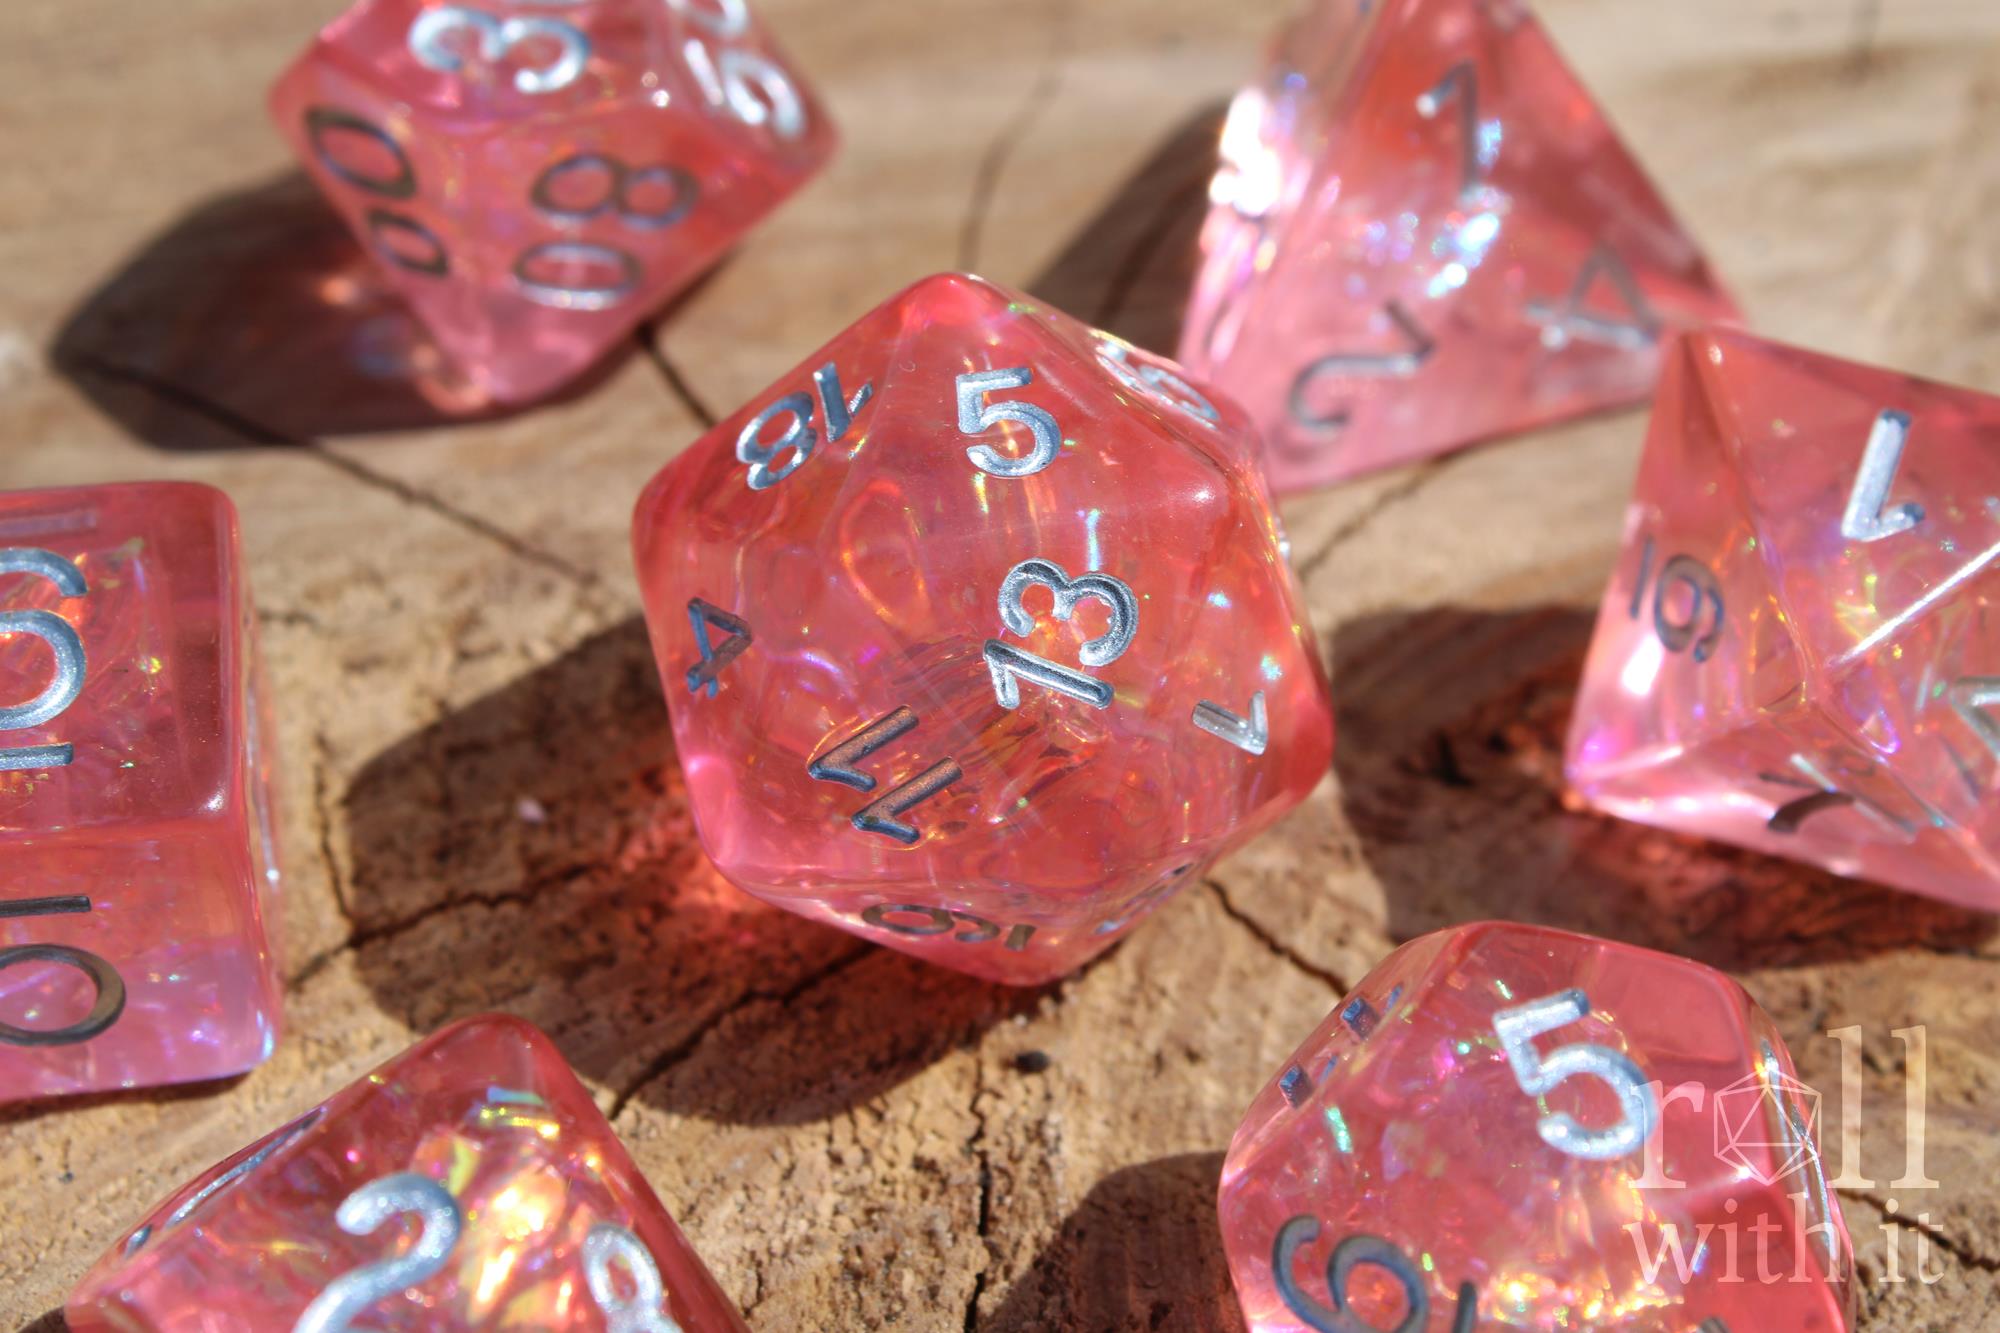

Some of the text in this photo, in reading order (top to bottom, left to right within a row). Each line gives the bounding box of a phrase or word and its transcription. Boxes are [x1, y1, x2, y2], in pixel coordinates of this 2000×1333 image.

[408, 0, 592, 94] 3
[512, 153, 699, 311] 80
[736, 361, 874, 491] 18
[955, 366, 1062, 479] 5
[1287, 299, 1437, 432] 2
[687, 597, 754, 699] 4
[983, 557, 1139, 710] 13
[808, 703, 964, 845] 11
[1493, 987, 1660, 1160] 5
